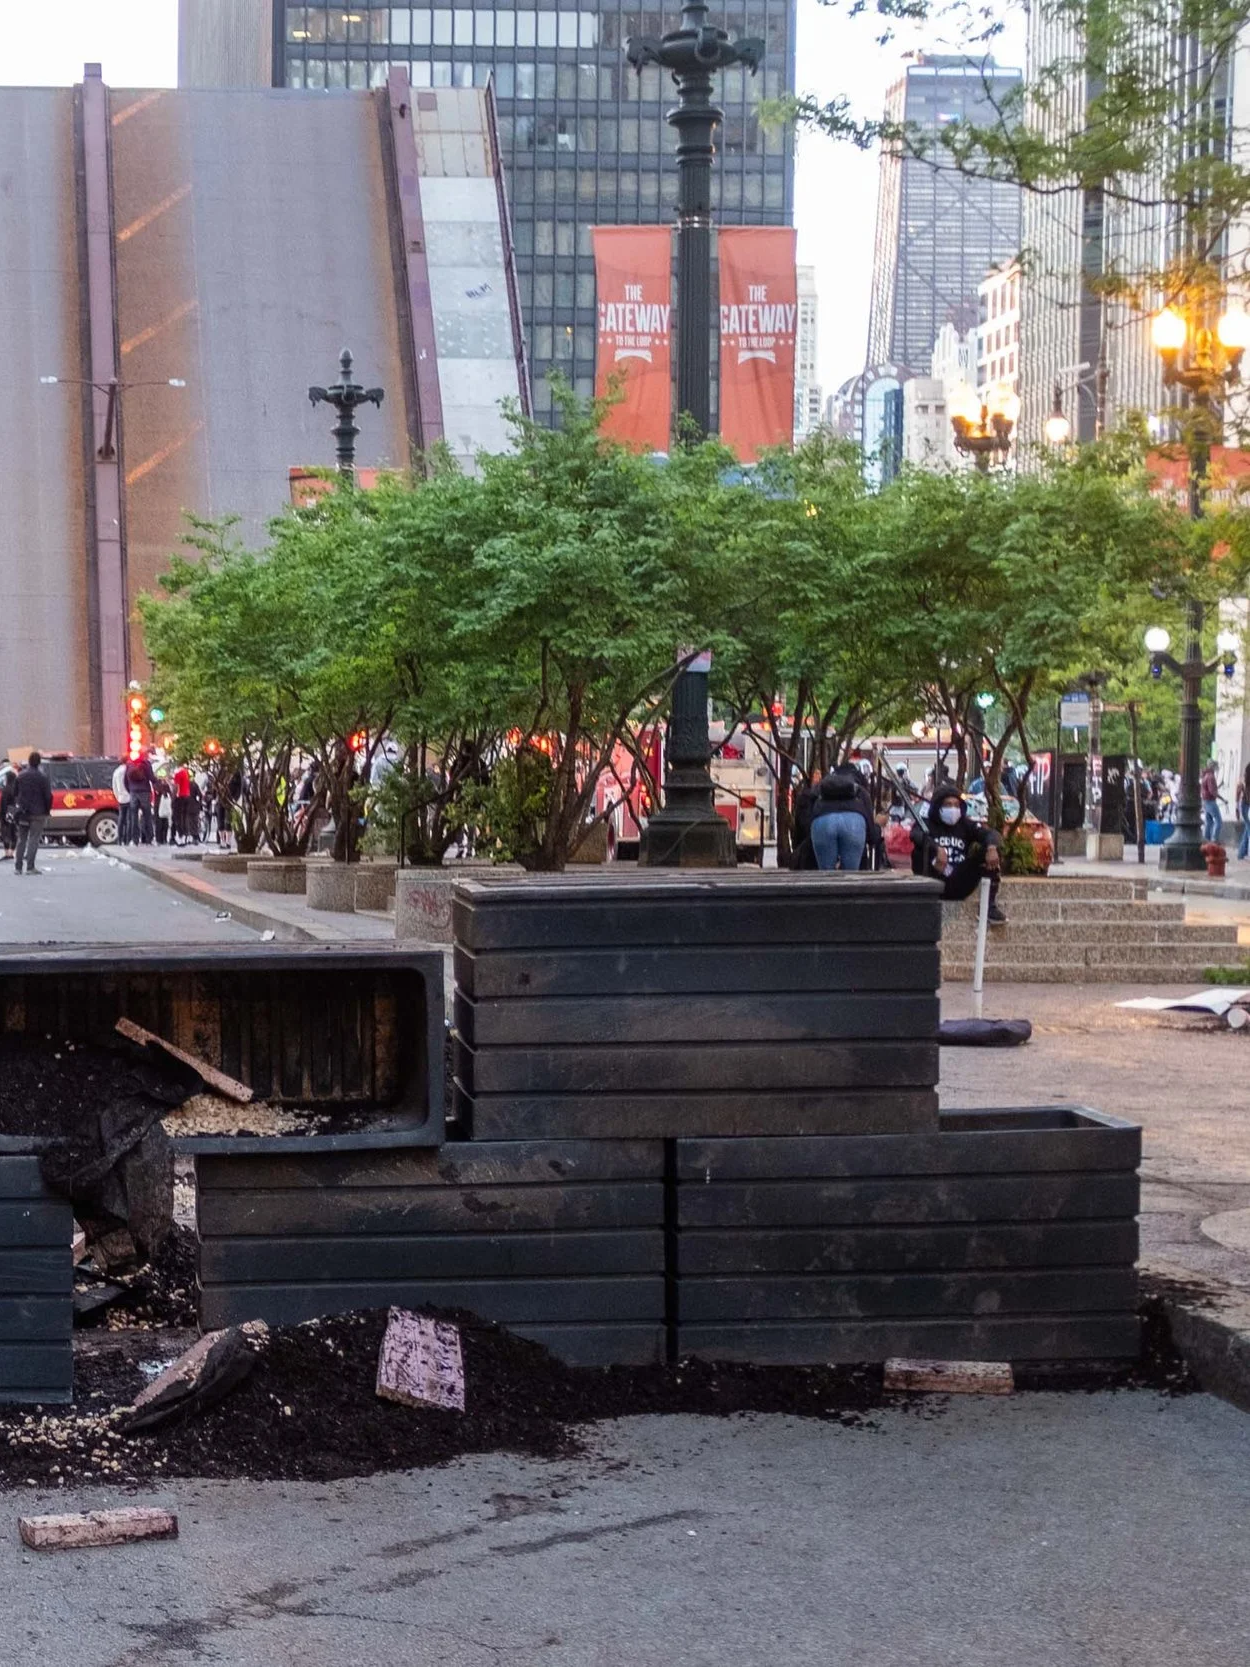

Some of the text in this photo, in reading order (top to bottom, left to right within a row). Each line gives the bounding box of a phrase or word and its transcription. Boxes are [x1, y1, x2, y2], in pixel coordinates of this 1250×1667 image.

[624, 285, 642, 301] THE
[748, 285, 767, 301] THE
[720, 304, 796, 334] GATEWAY
[636, 335, 652, 348] LOOP
[759, 336, 776, 348] LOOP
